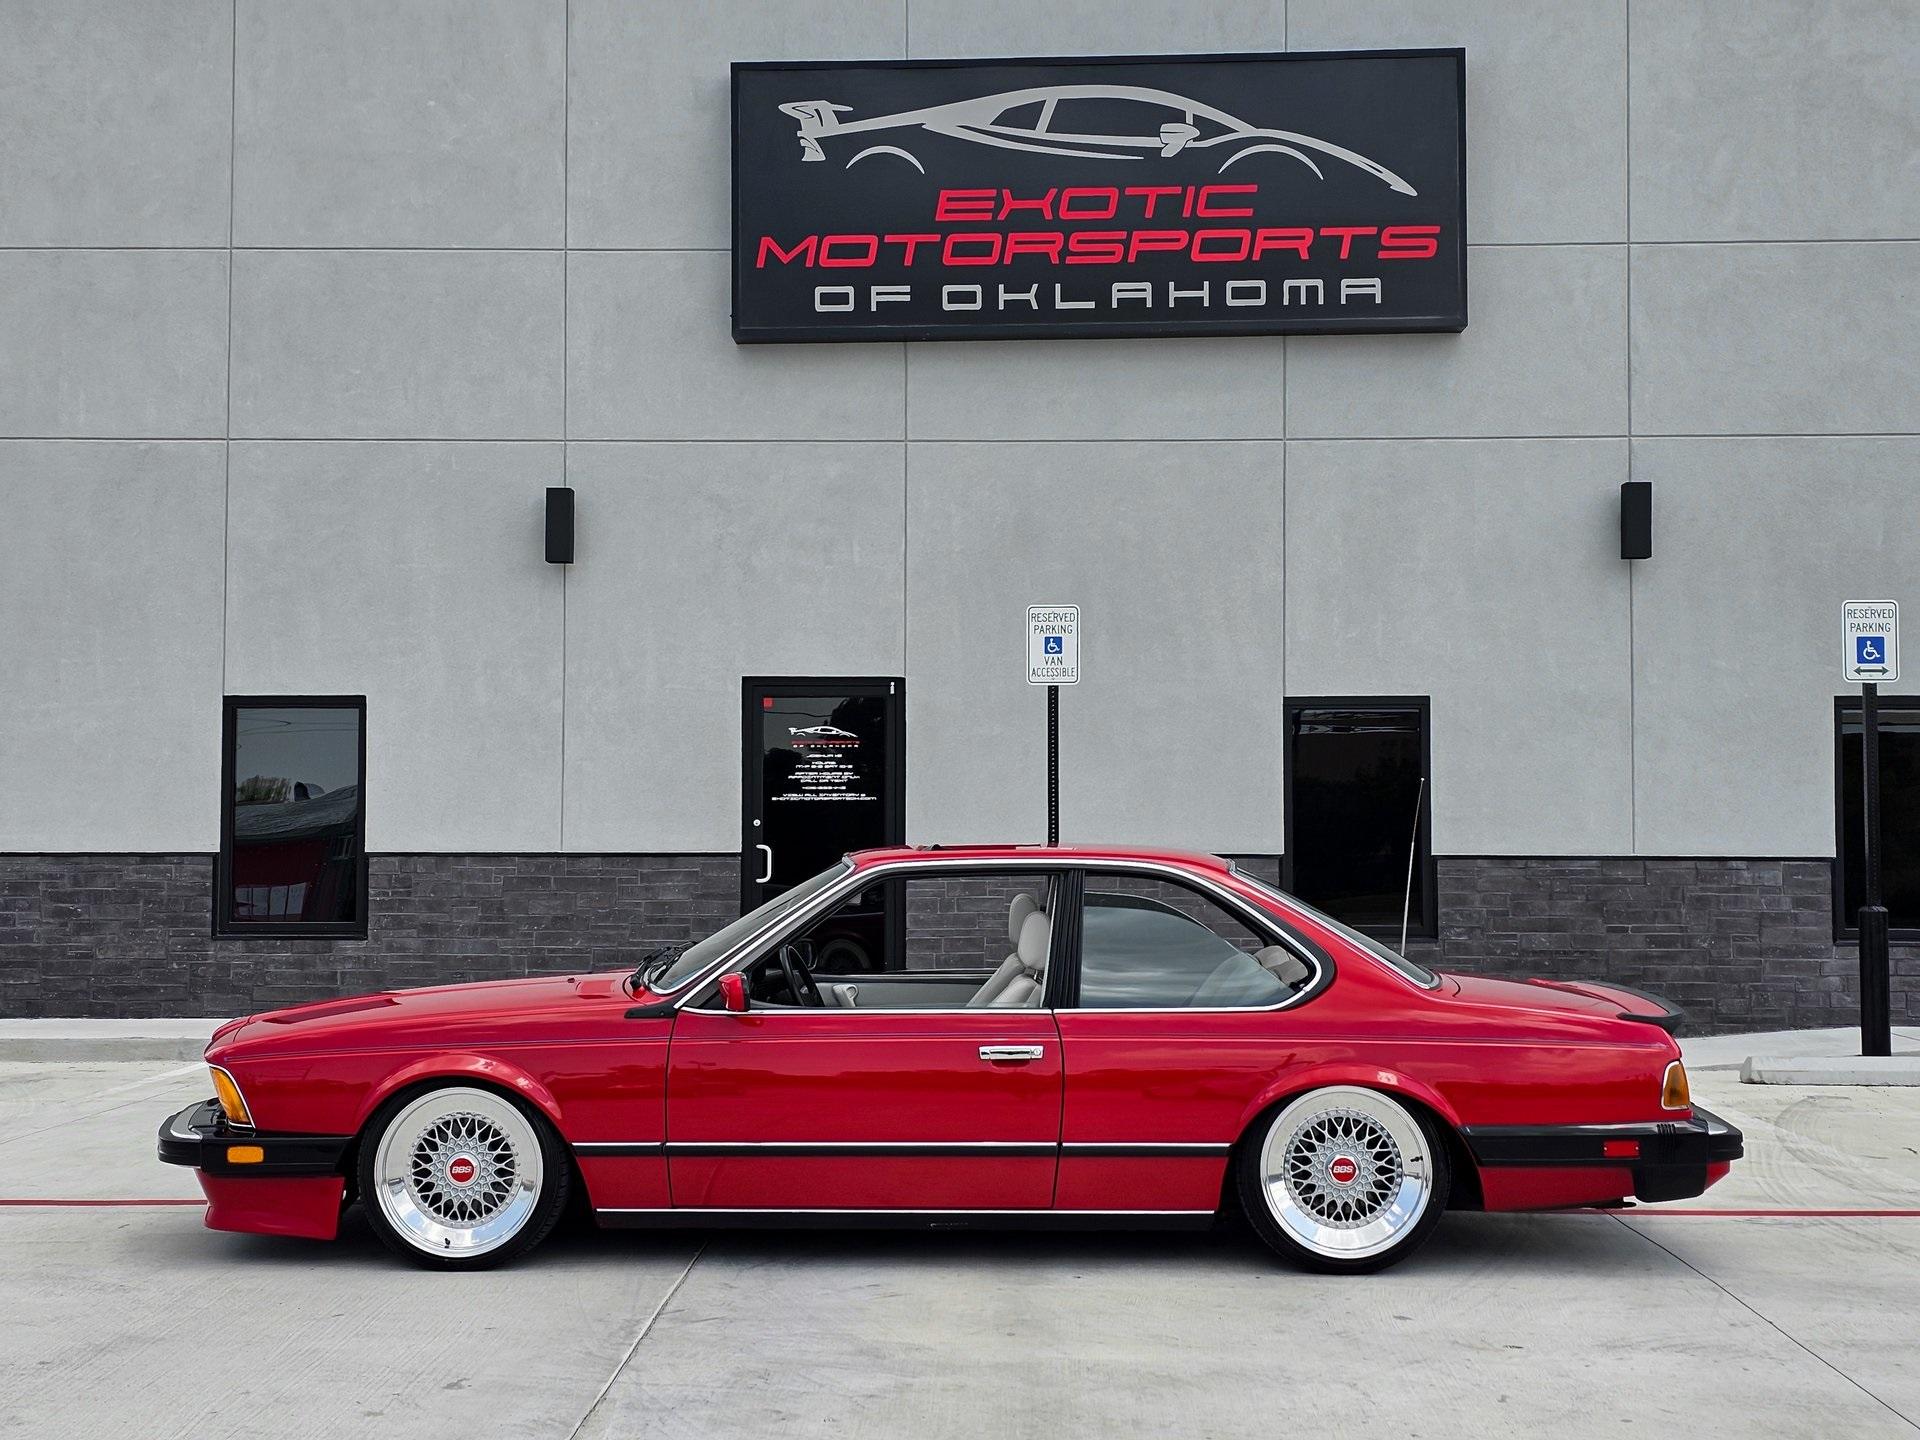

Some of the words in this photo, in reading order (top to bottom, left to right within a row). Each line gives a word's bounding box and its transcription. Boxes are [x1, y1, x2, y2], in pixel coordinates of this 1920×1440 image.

[935, 184, 1258, 222] EXOTIC
[756, 225, 1441, 268] MOTORSPORTS
[814, 285, 911, 313] OF
[942, 277, 1382, 313] OKLAHOMA
[1031, 612, 1075, 622] RESERVED
[1847, 609, 1894, 619] RESERVED
[1033, 625, 1073, 634] PARKING
[1850, 623, 1891, 632] PARKING
[1044, 656, 1063, 666] VAN
[1031, 667, 1076, 677] ACCESSIBLE
[452, 1166, 472, 1174] BBS
[1333, 1166, 1354, 1174] BBS
